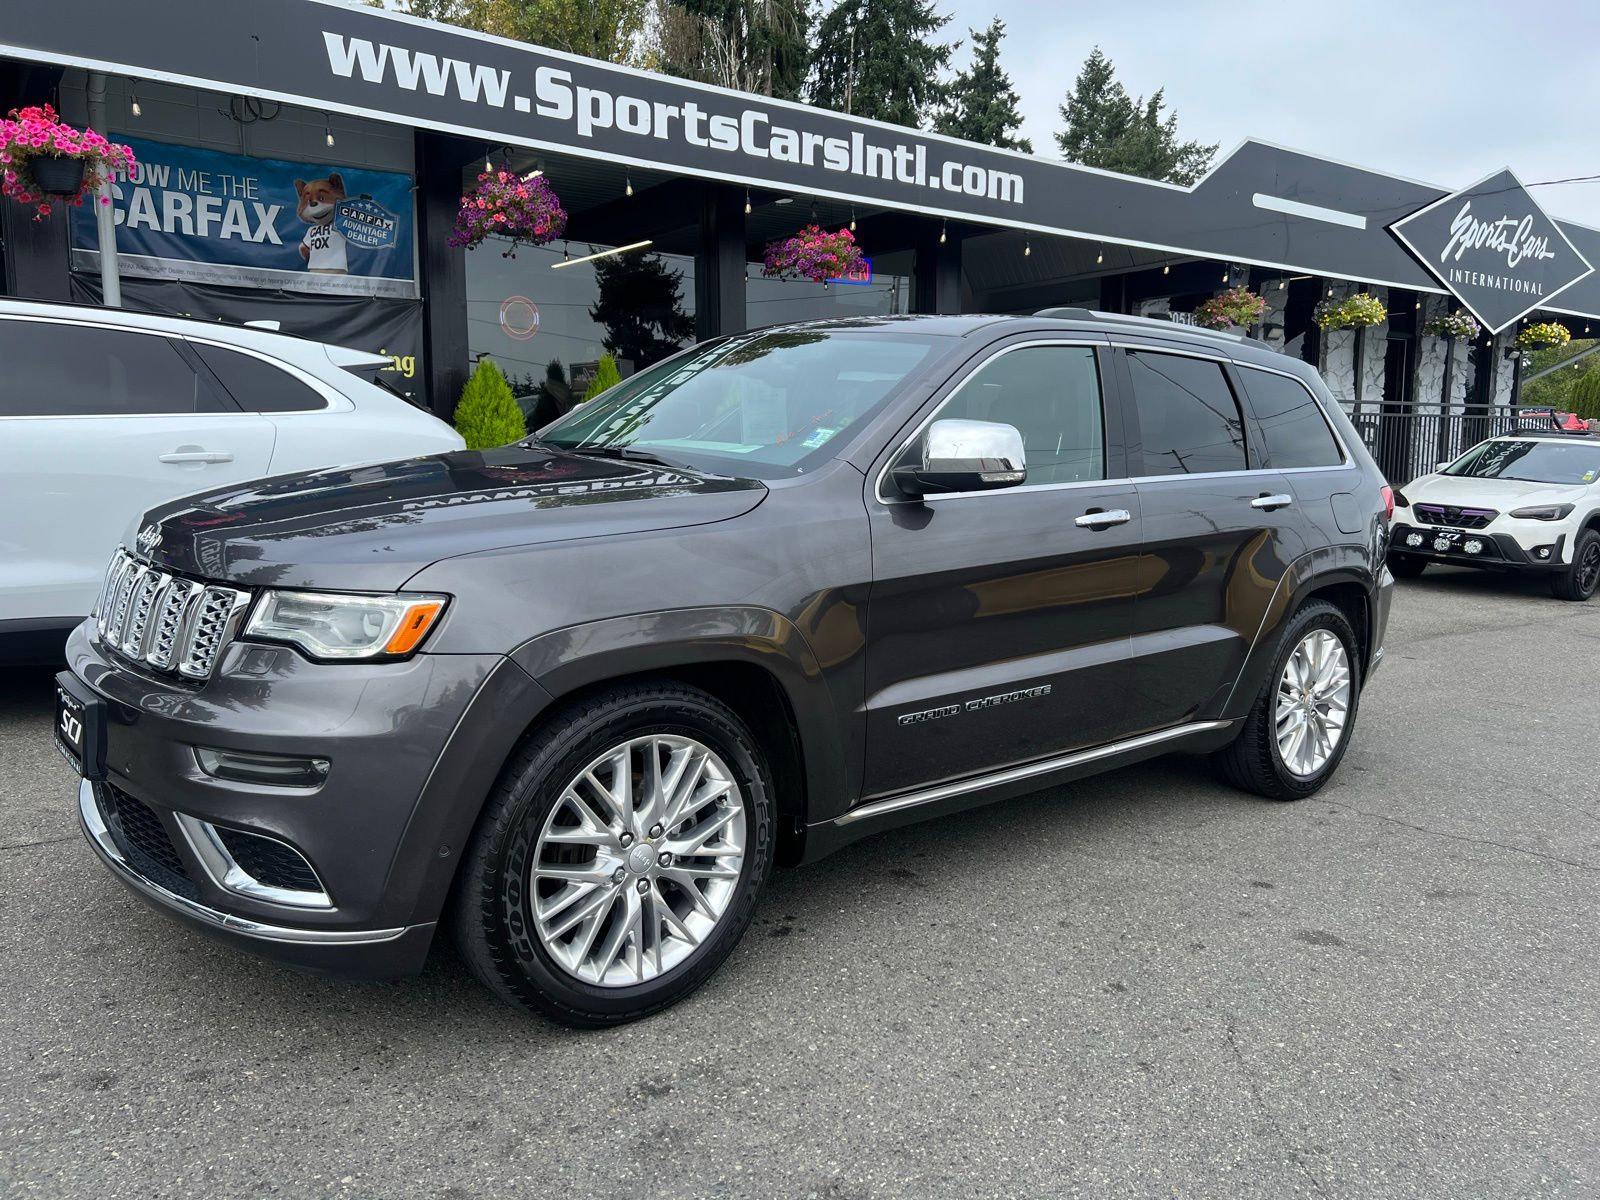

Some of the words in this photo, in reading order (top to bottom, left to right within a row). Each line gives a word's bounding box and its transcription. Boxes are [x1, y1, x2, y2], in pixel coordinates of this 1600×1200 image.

[322, 31, 1025, 204] www.SportsCarsIntl.com
[178, 167, 213, 194] ME
[217, 174, 259, 200] THE
[310, 224, 332, 238] CAR
[341, 207, 393, 231] CARFAX
[342, 219, 388, 240] ADVANTAGE
[310, 237, 330, 251] FOX
[347, 230, 379, 246] DEALER
[1441, 200, 1516, 263] Sports
[1507, 214, 1555, 268] Cars
[1449, 269, 1543, 295] INTERNATIONAL
[897, 704, 961, 726] GRAND
[965, 684, 1052, 712] CHEROKEE
[60, 708, 82, 745] SCI
